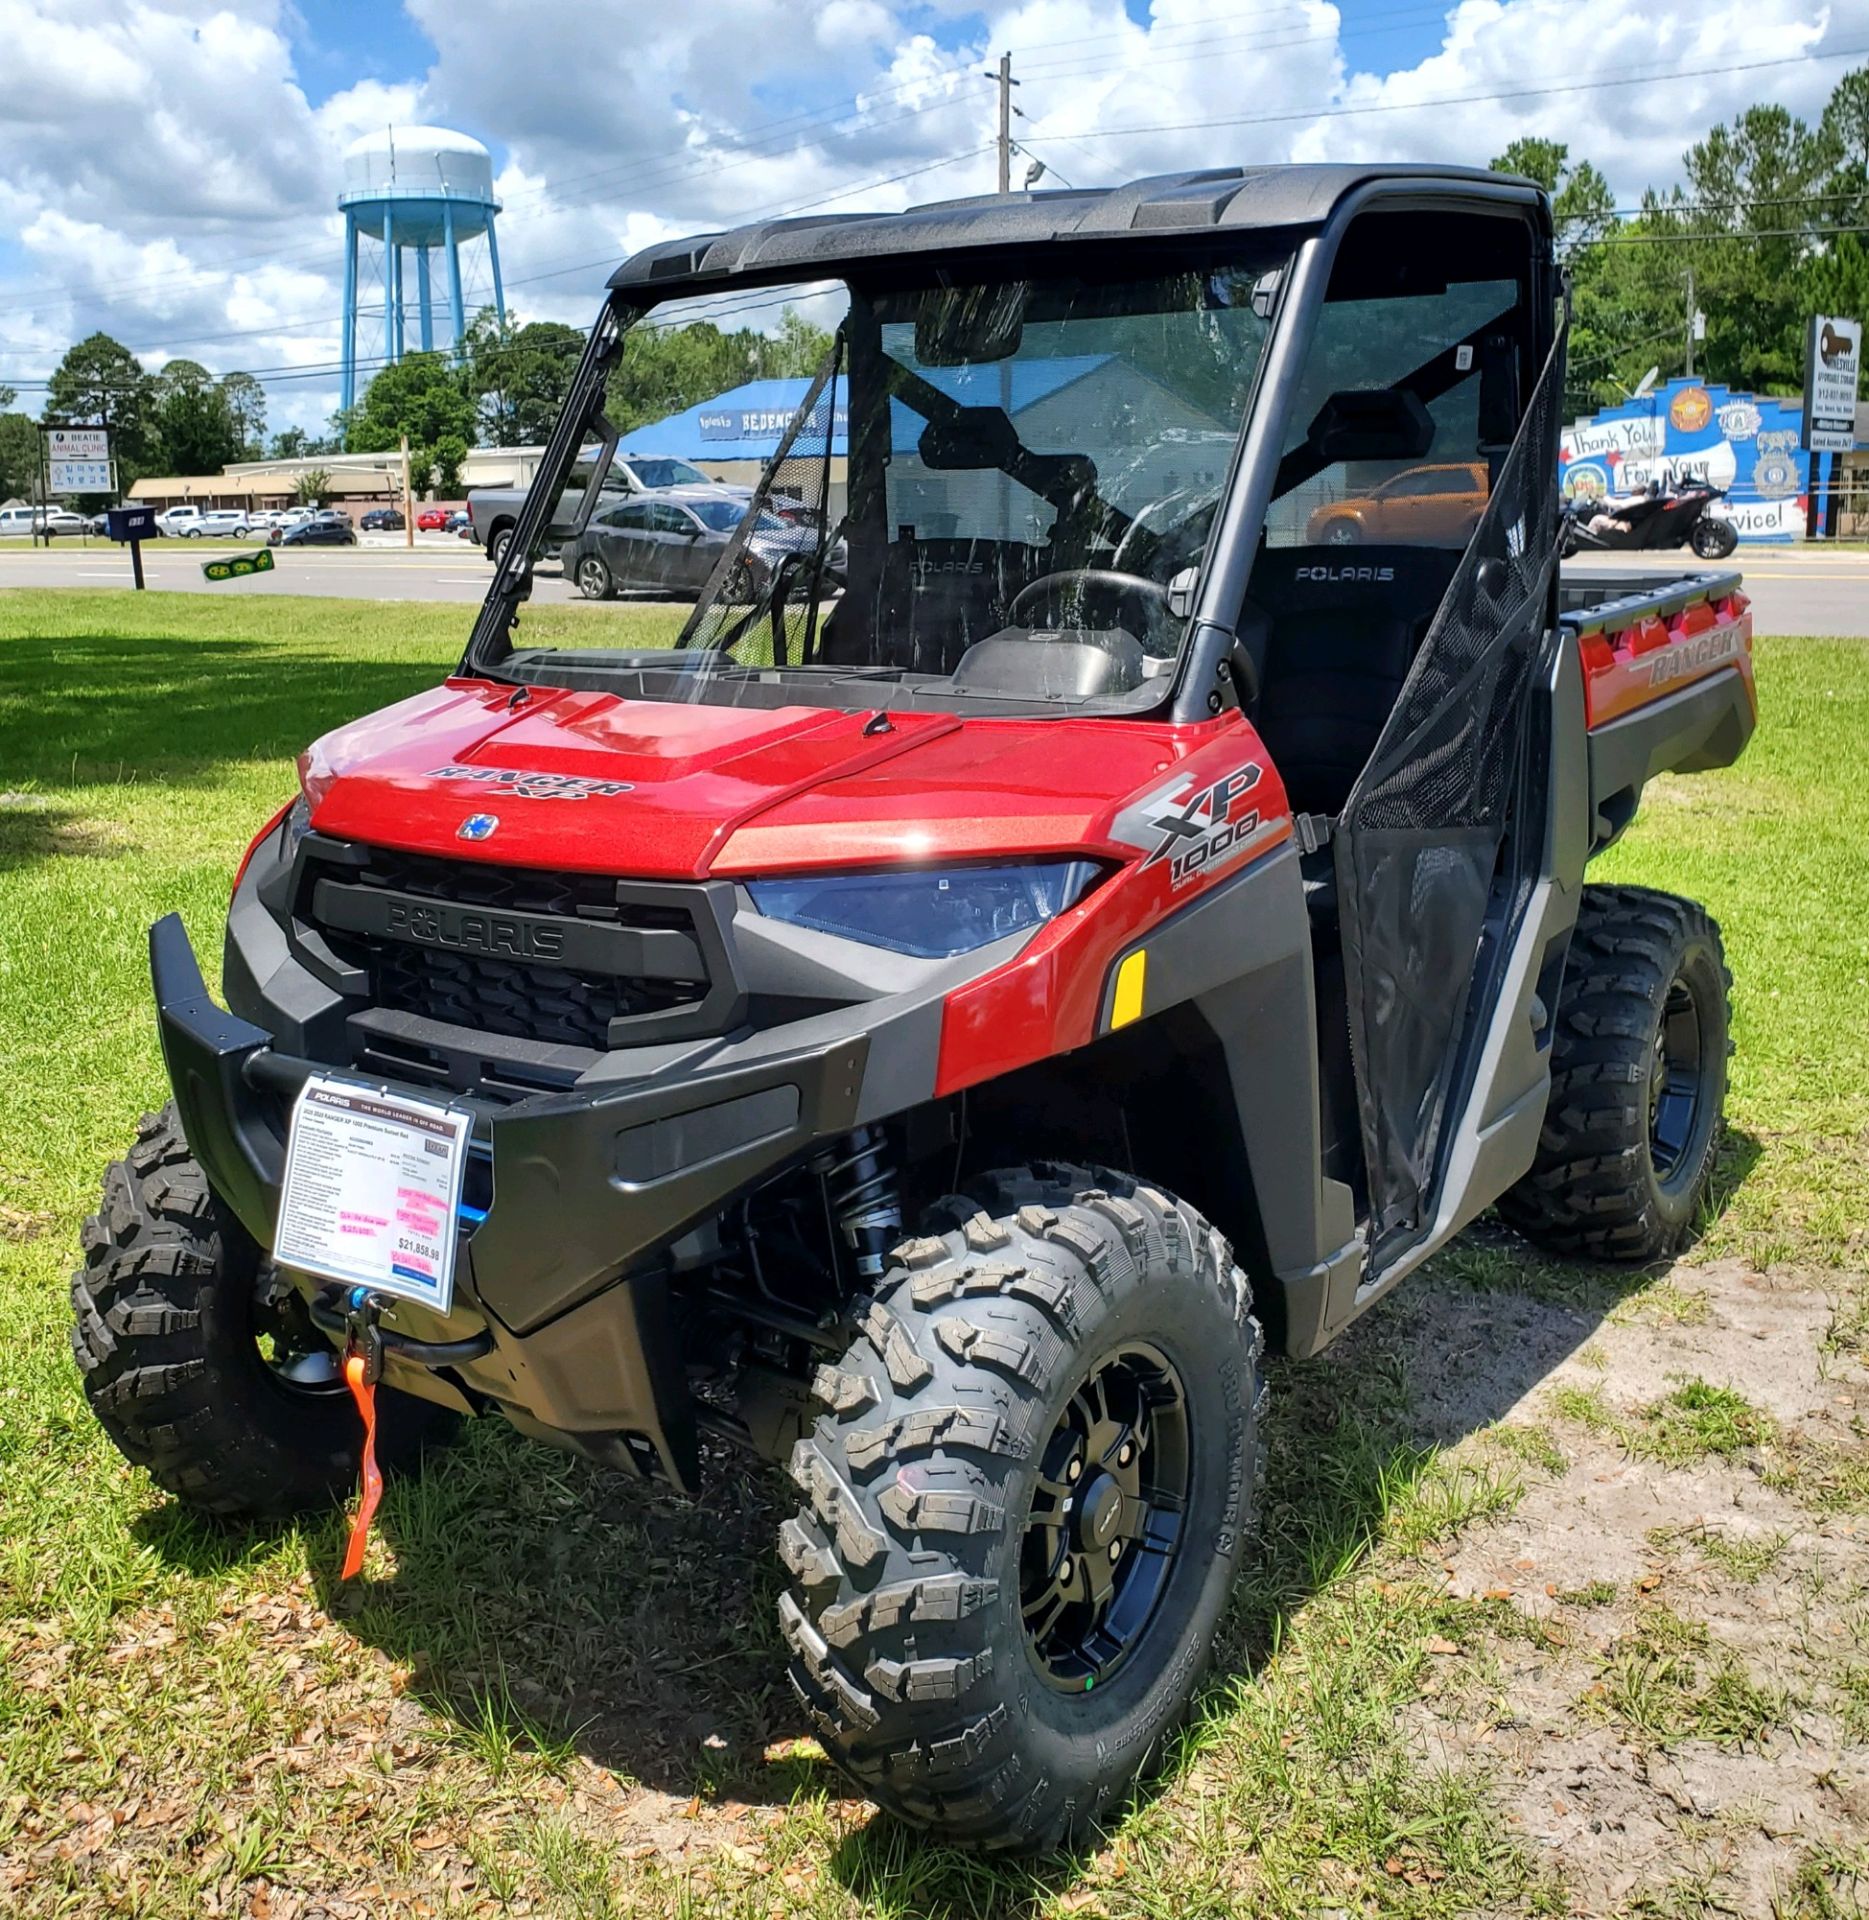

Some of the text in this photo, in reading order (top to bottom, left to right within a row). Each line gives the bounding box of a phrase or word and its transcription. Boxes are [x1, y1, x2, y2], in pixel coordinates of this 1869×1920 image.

[52, 443, 107, 453] ANIMAL CLINIC
[1574, 424, 1653, 455] Thank You
[1624, 457, 1709, 485] For Your
[1295, 567, 1394, 581] POLARIS
[1649, 631, 1735, 688] RANGER
[422, 766, 636, 796] RANGER
[1137, 762, 1263, 874] XP
[1171, 808, 1259, 884] 1000
[386, 902, 564, 960] POLARIS
[315, 1091, 351, 1107] POLARIS
[361, 1104, 372, 1112] THE
[372, 1106, 392, 1117] WORLD
[392, 1111, 413, 1122] LEADER
[420, 1119, 430, 1127] OFF
[399, 1238, 440, 1261] $21,858.98
